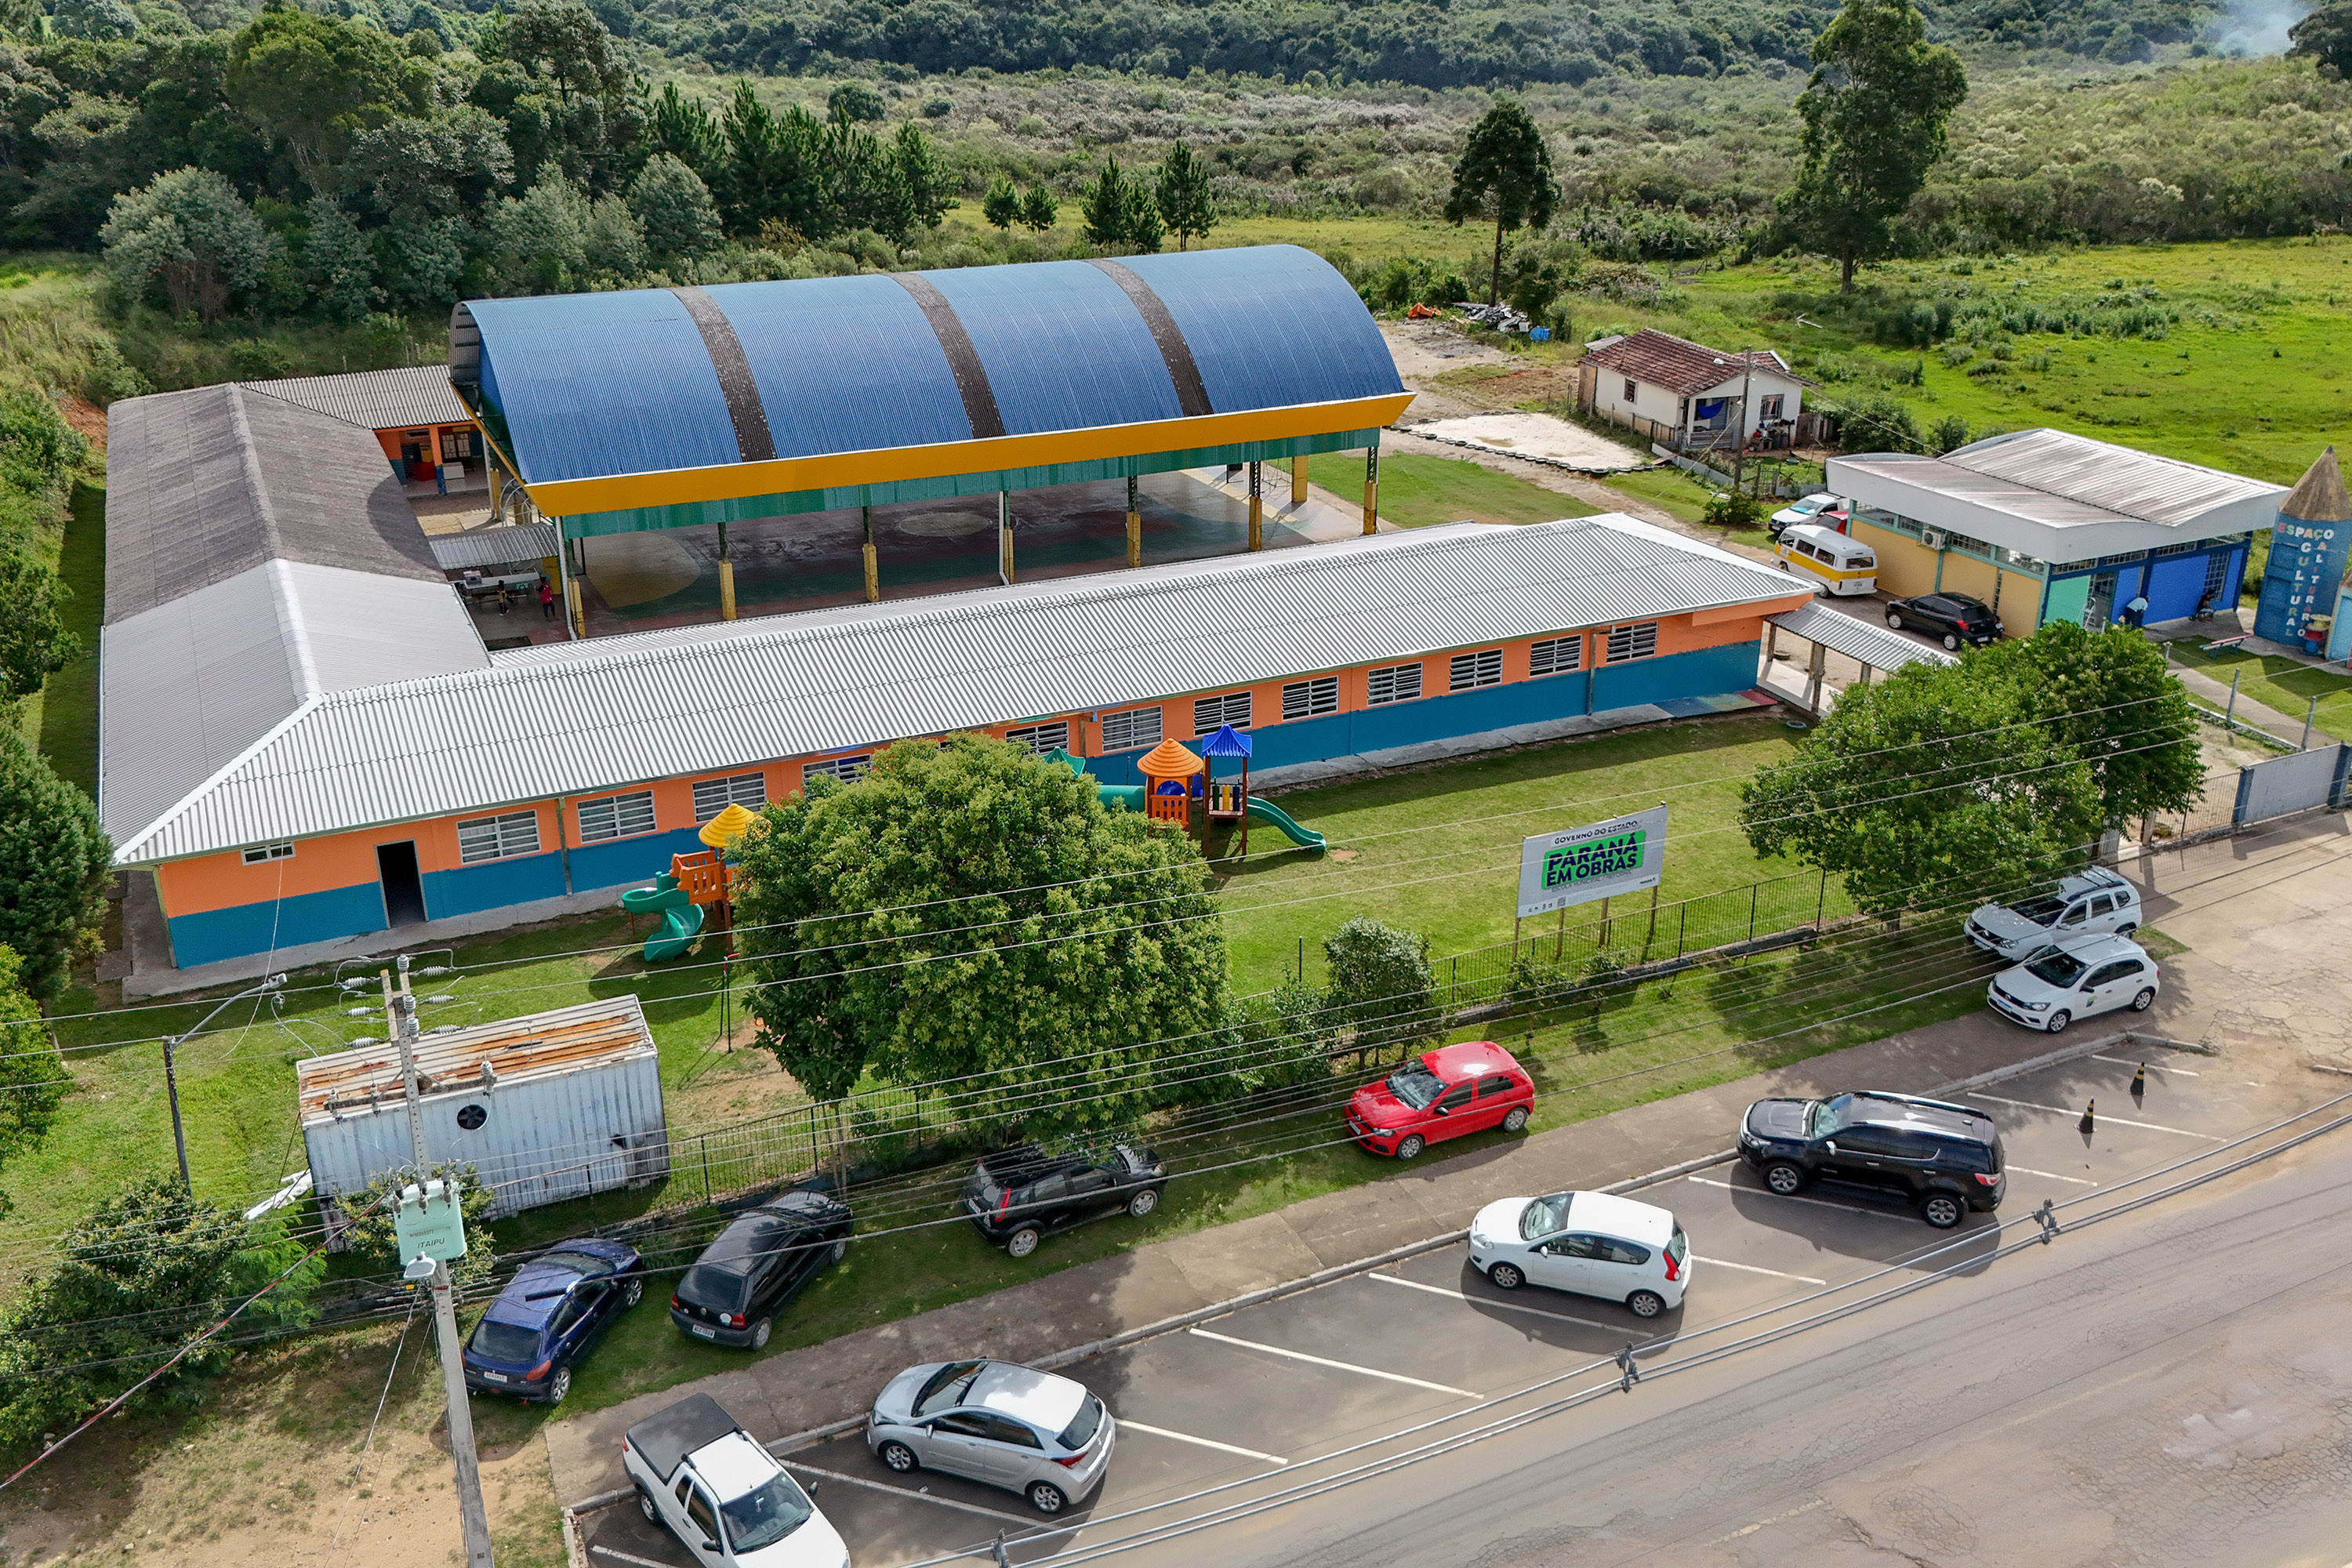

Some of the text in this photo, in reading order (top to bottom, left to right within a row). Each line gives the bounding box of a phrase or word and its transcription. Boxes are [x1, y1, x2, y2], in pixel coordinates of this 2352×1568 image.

[2278, 522, 2334, 541] ESPAÇO
[2285, 542, 2311, 637] CULTURAL
[1555, 820, 1638, 844] GOVERNO DO ESTADO
[1548, 832, 1638, 871] PARANÁ
[1546, 853, 1637, 887] EM OBRAS
[417, 1237, 445, 1249] ITAIPU
